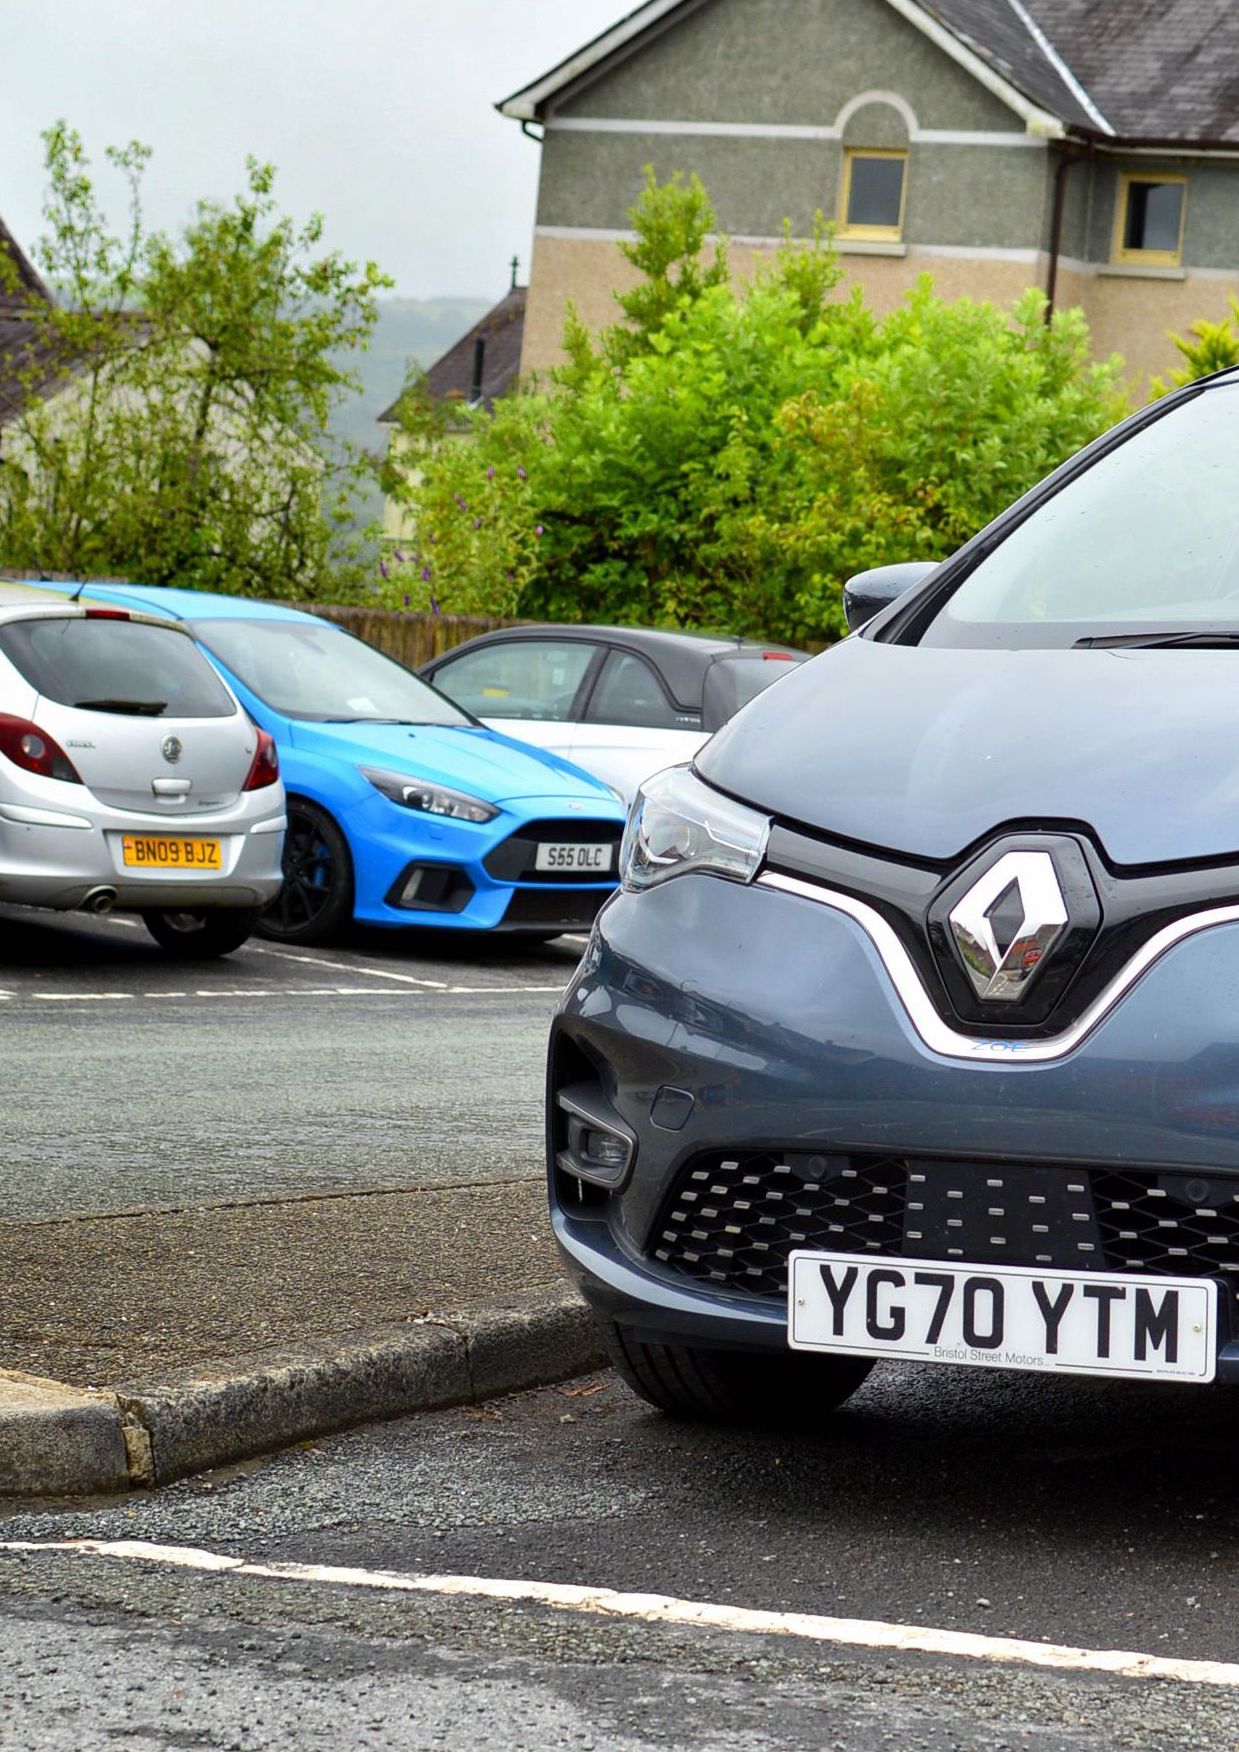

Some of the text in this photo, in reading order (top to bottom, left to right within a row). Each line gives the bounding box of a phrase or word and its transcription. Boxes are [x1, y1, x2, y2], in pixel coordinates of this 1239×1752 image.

[134, 840, 218, 864] BN09 BJZ
[547, 846, 603, 867] S55 OLC
[819, 1263, 1180, 1364] YG70 YTM
[934, 1346, 1044, 1367] Bristol Street Motors
